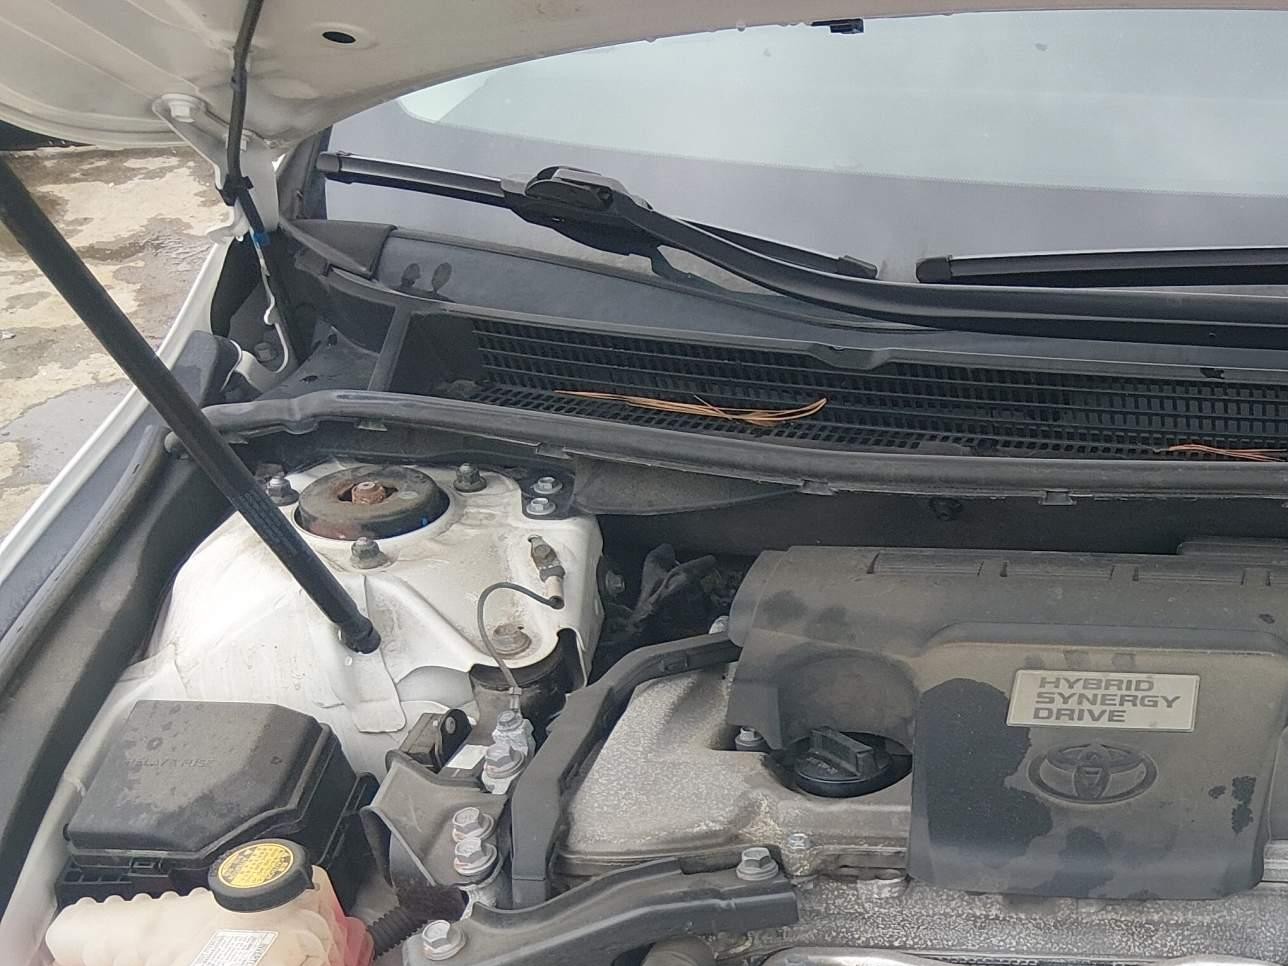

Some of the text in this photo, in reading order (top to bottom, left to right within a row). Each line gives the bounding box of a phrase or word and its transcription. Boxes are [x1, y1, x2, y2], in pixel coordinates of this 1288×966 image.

[1039, 676, 1155, 692] HYBRID
[1035, 691, 1181, 708] SYNERGY
[1033, 707, 1127, 723] DRIVE
